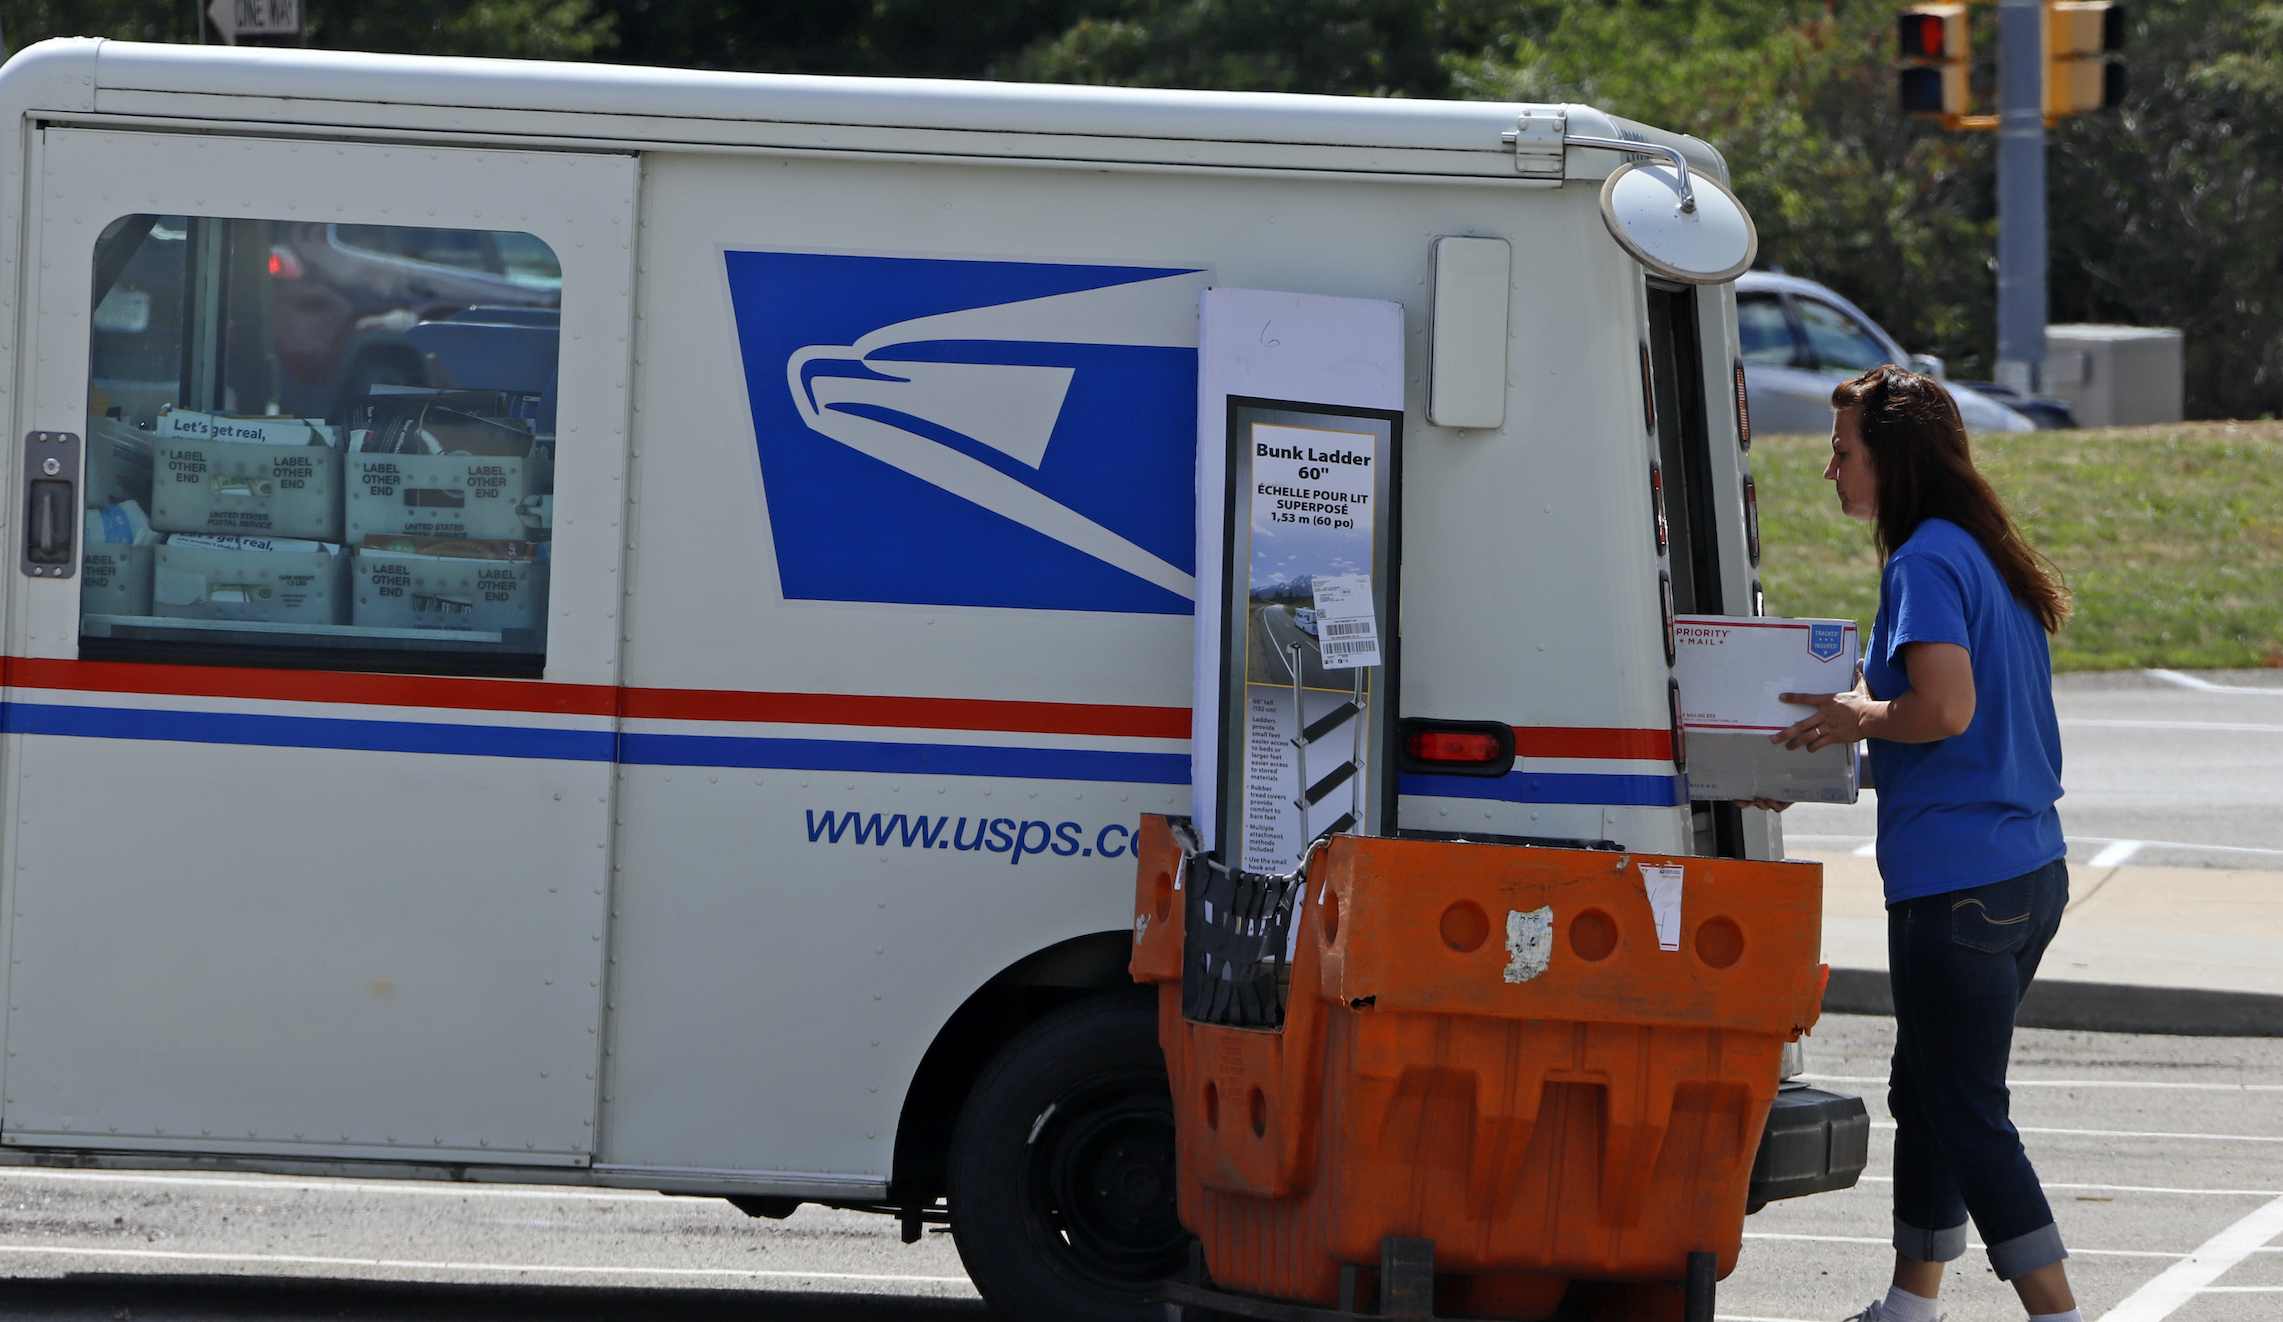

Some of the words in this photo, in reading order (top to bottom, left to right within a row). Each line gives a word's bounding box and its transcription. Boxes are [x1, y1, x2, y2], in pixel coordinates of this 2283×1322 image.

[234, 0, 264, 27] ONE
[1260, 320, 1280, 347] 6
[174, 419, 208, 434] Let's
[212, 426, 233, 438] get
[236, 428, 266, 442] real,
[170, 450, 206, 462] LABEL
[1256, 443, 1304, 460] Bunk
[1308, 448, 1371, 466] Ladder
[274, 457, 312, 467] LABEL
[168, 462, 207, 473] OTHER
[363, 463, 400, 474] LABEL
[468, 466, 506, 476] LABEL
[273, 468, 313, 478] OTHER
[1298, 466, 1329, 480] 60"
[176, 473, 199, 484] END
[362, 474, 401, 485] OTHER
[467, 478, 506, 488] OTHER
[280, 480, 305, 489] END
[370, 486, 394, 496] END
[475, 489, 499, 498] END
[1258, 483, 1310, 499] ÉCHELLE
[1313, 490, 1348, 502] POUR
[1350, 494, 1369, 504] LIT
[1277, 499, 1348, 515] SUPERPOSÉ
[210, 511, 239, 519] UNITED
[240, 512, 269, 521] STATES
[1271, 512, 1296, 523] 1,53
[1298, 516, 1310, 524] m
[1313, 515, 1331, 526] (60
[1334, 519, 1354, 530] po)
[207, 518, 237, 527] POSTAL
[239, 520, 273, 529] SERVICE
[434, 524, 465, 532] STATES
[243, 540, 273, 552] real,
[85, 555, 116, 565] ABEL
[85, 566, 116, 576] THER
[373, 564, 410, 575] LABEL
[478, 570, 516, 580] LABEL
[84, 578, 109, 587] END
[372, 575, 411, 586] OTHER
[478, 581, 517, 591] OTHER
[380, 587, 403, 597] END
[485, 592, 509, 601] END
[1676, 628, 1731, 638] PRIORITY
[1688, 638, 1715, 646] MAIL
[1252, 716, 1276, 724] Ladders
[1252, 752, 1269, 760] larger
[1250, 824, 1274, 832] Multiple
[806, 809, 1139, 864] www.usps.c
[1250, 832, 1284, 840] attachment
